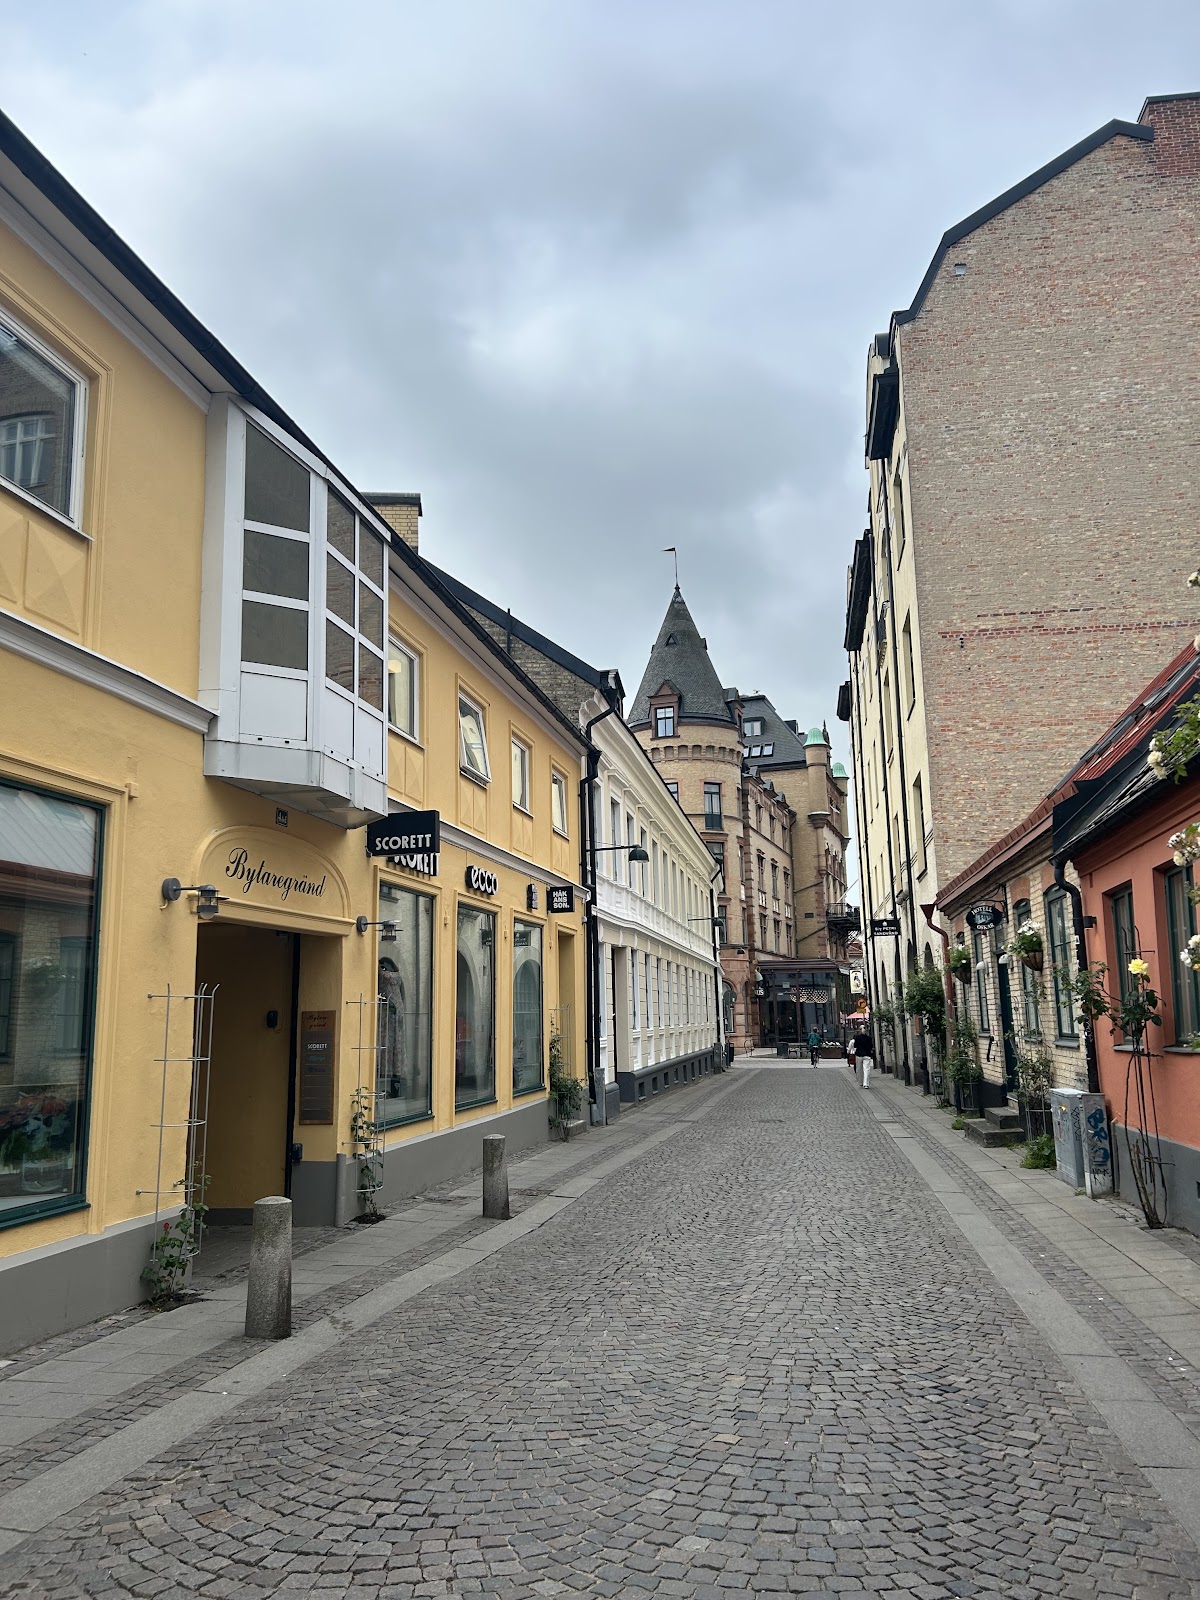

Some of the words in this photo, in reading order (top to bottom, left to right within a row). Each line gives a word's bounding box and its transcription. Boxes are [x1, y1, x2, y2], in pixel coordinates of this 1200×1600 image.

[375, 833, 432, 851] SCORETT
[225, 847, 327, 902] Bytaregränd
[471, 865, 498, 895] ecco
[971, 906, 993, 915] HOTELL
